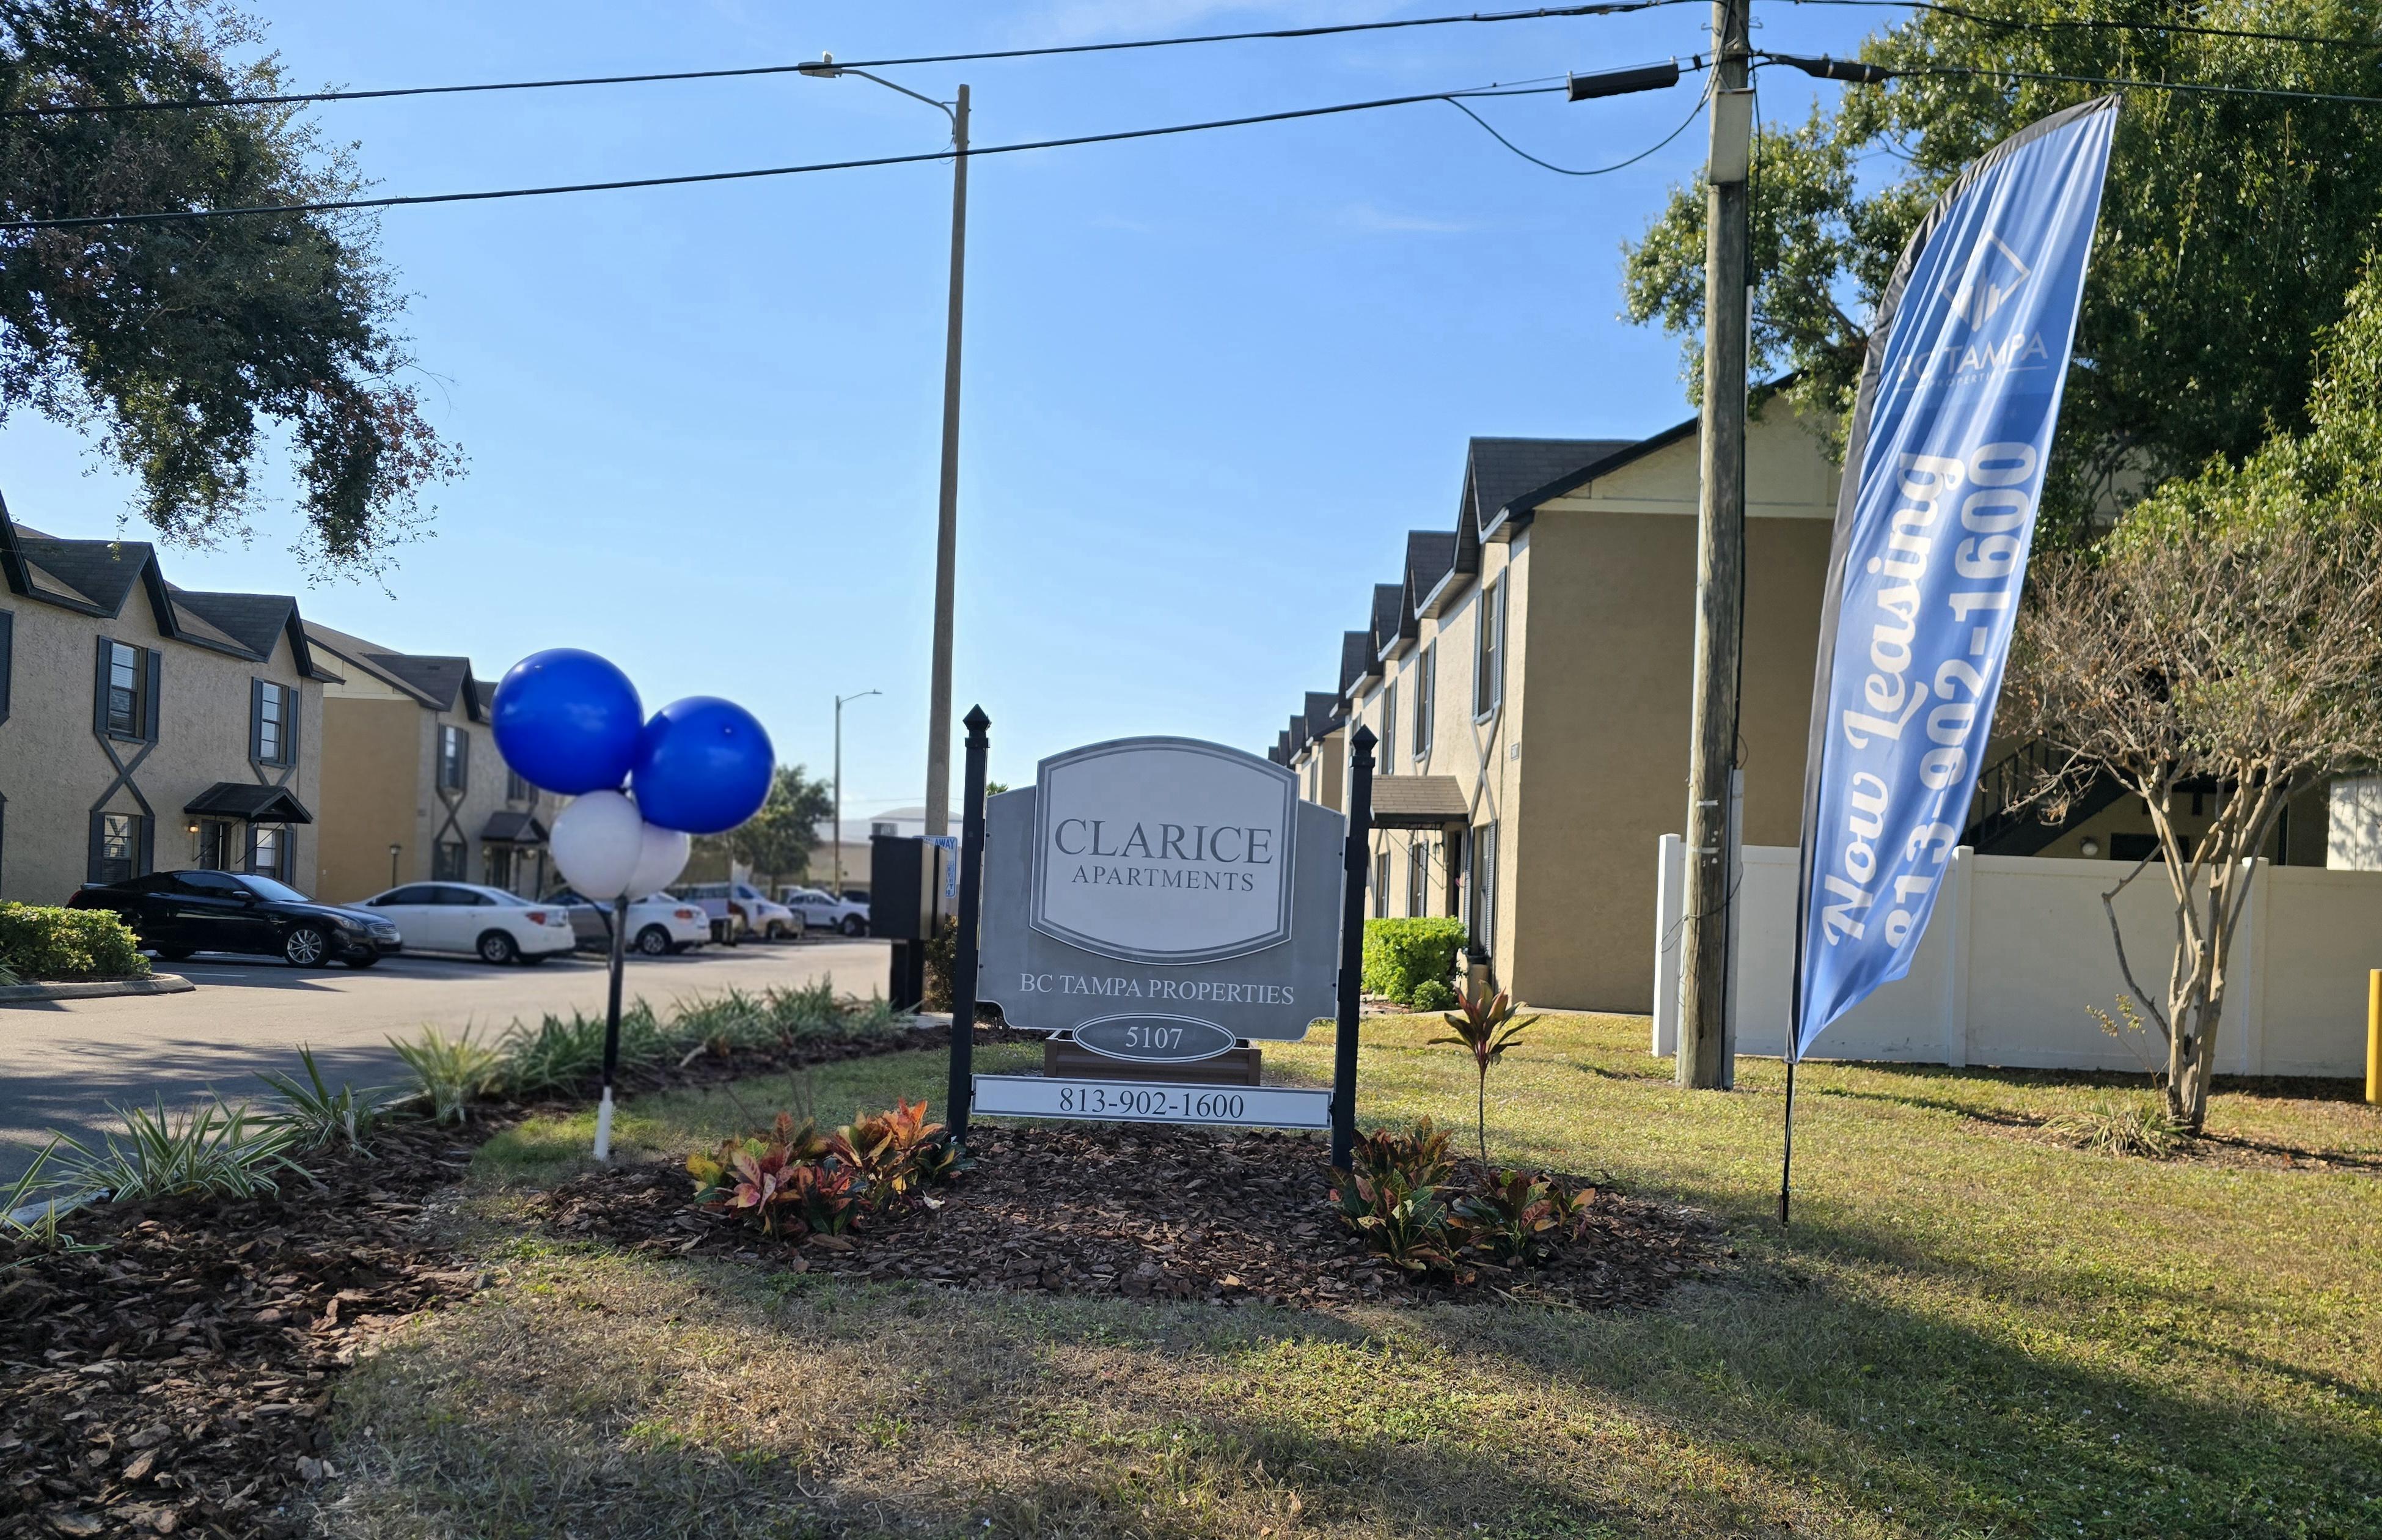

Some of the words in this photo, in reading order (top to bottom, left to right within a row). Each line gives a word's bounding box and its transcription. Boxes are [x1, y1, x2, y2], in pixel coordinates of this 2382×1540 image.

[1945, 332, 2049, 374] TAMPA
[1843, 452, 1965, 750] Leasing
[1055, 818, 1273, 864] CLARICE
[1822, 771, 1888, 946] Now
[1071, 865, 1253, 892] APARTMENTS
[1019, 973, 1053, 993] BC
[1060, 975, 1143, 997] TAMPA
[1148, 979, 1294, 1005] PROPERTIES
[1125, 1026, 1183, 1049] 5107
[1059, 1087, 1244, 1119] 813-902-1600
